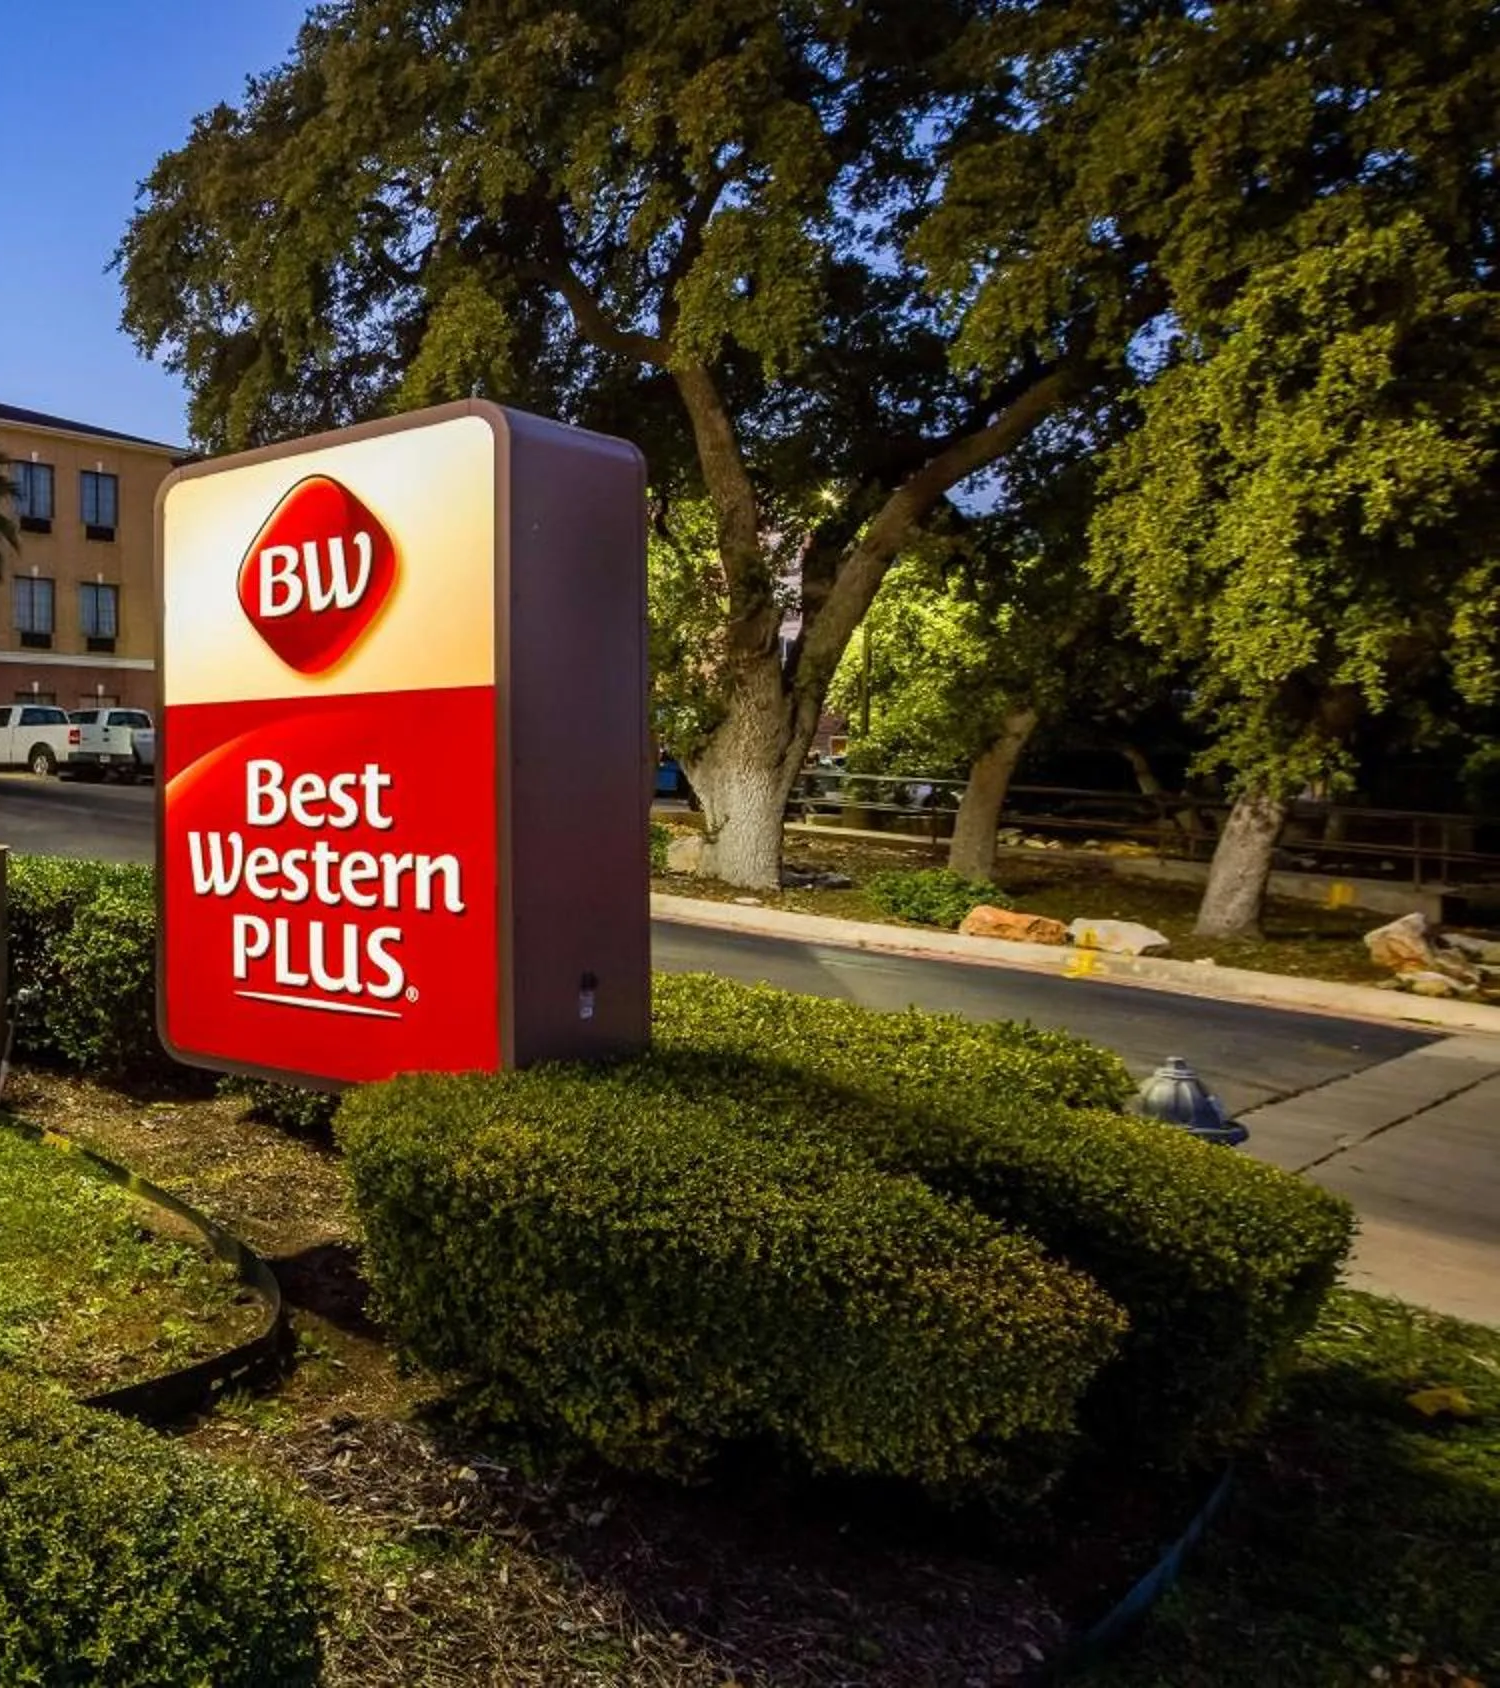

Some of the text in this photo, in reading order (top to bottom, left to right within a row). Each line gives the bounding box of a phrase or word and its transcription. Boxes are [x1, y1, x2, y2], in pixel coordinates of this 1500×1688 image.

[258, 531, 373, 617] BW
[245, 758, 393, 830] Best
[187, 831, 466, 913] Western
